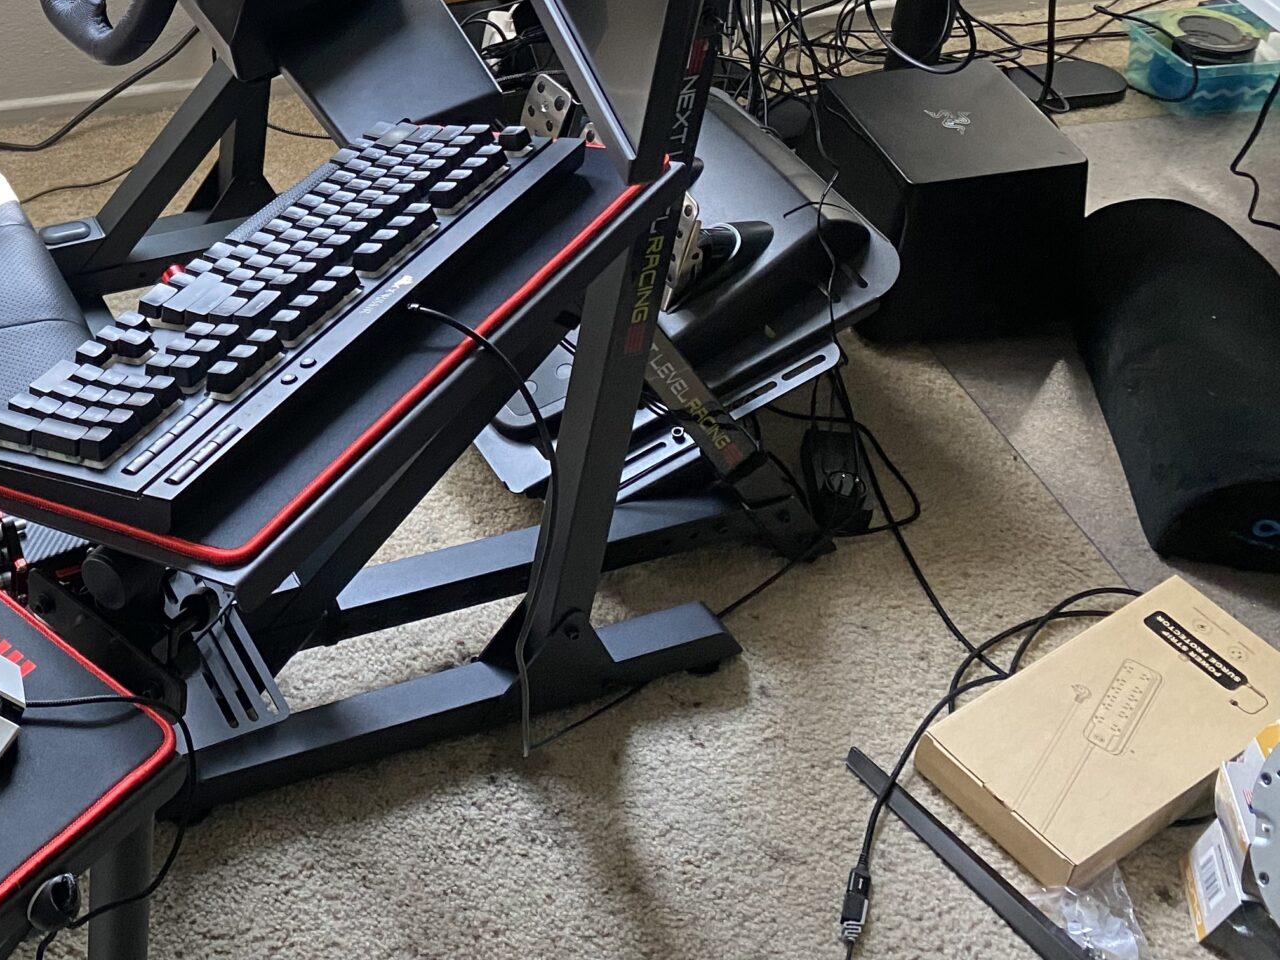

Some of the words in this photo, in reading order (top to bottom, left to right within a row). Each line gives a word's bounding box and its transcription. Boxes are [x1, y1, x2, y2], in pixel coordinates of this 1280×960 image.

[669, 74, 700, 144] NEXT
[631, 235, 664, 324] RACING
[650, 354, 689, 404] LEVEL
[687, 398, 731, 450] RACING
[1155, 615, 1209, 657] PROTECTOR
[1161, 630, 1189, 652] STRIP
[1188, 651, 1222, 678] POWER
[1208, 657, 1241, 683] SURGE
